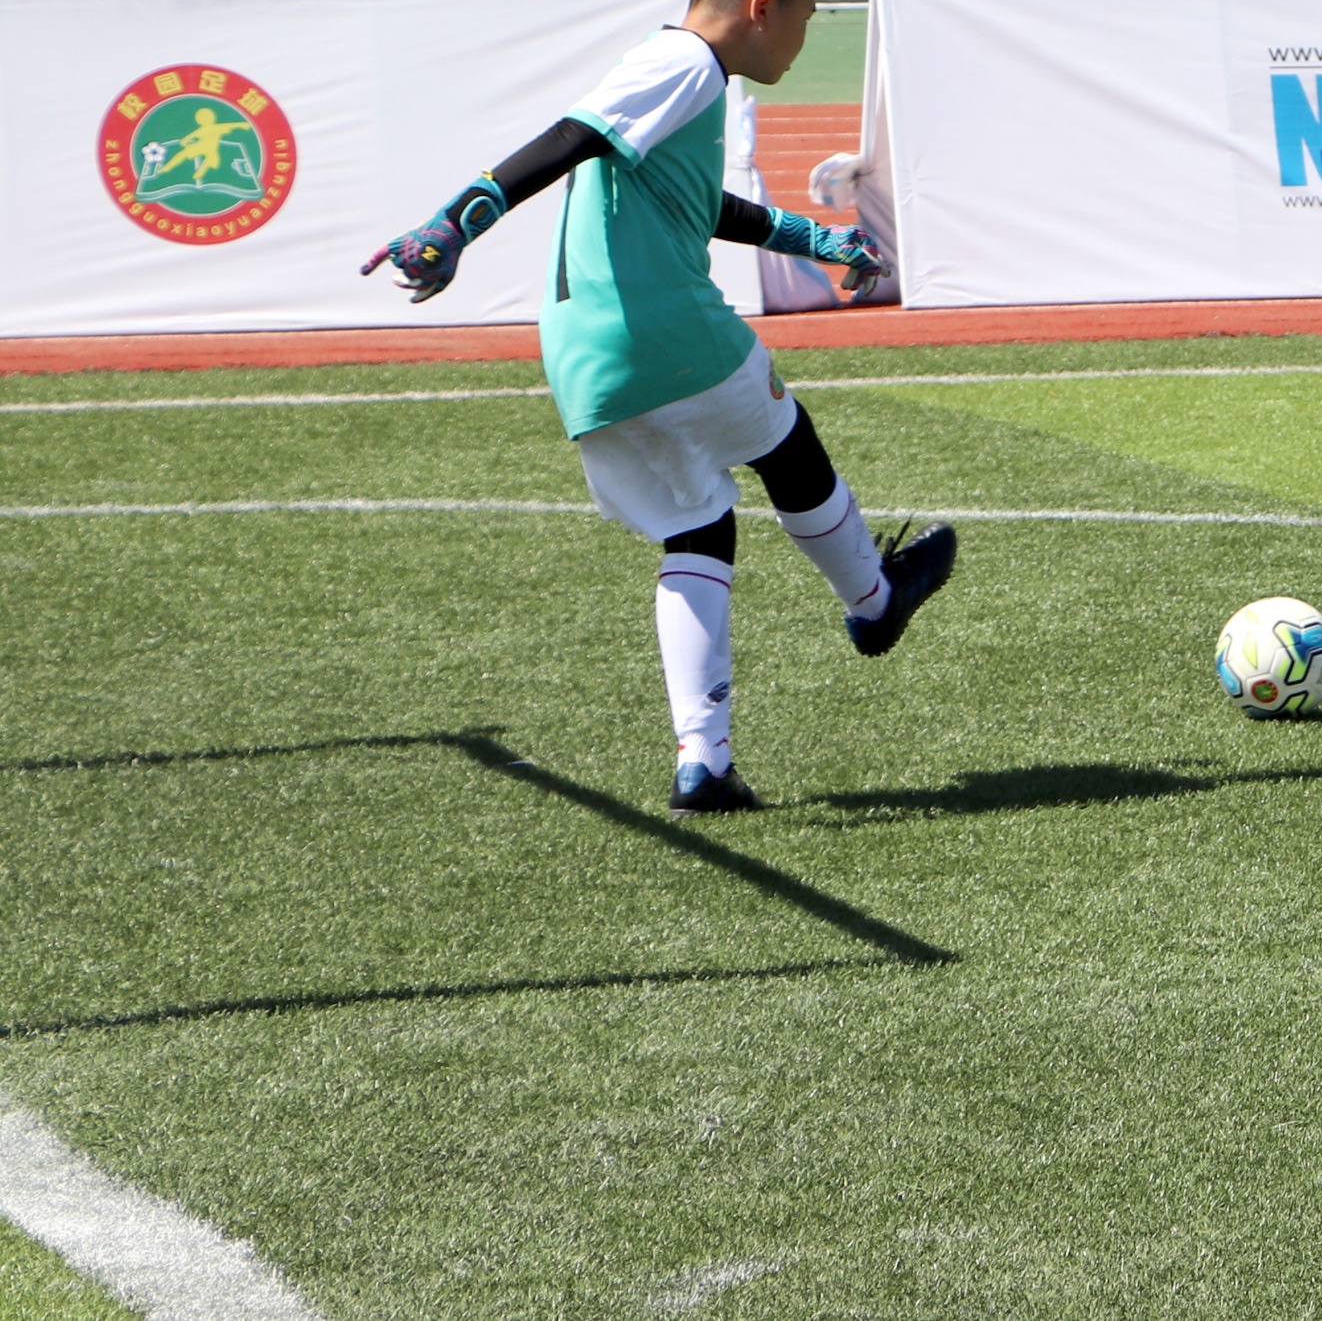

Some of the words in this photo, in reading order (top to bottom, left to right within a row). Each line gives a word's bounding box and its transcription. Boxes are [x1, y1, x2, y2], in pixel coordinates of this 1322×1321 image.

[117, 69, 268, 121] 校园足球
[105, 138, 291, 237] zhongguoxiaoyuanzuqiu
